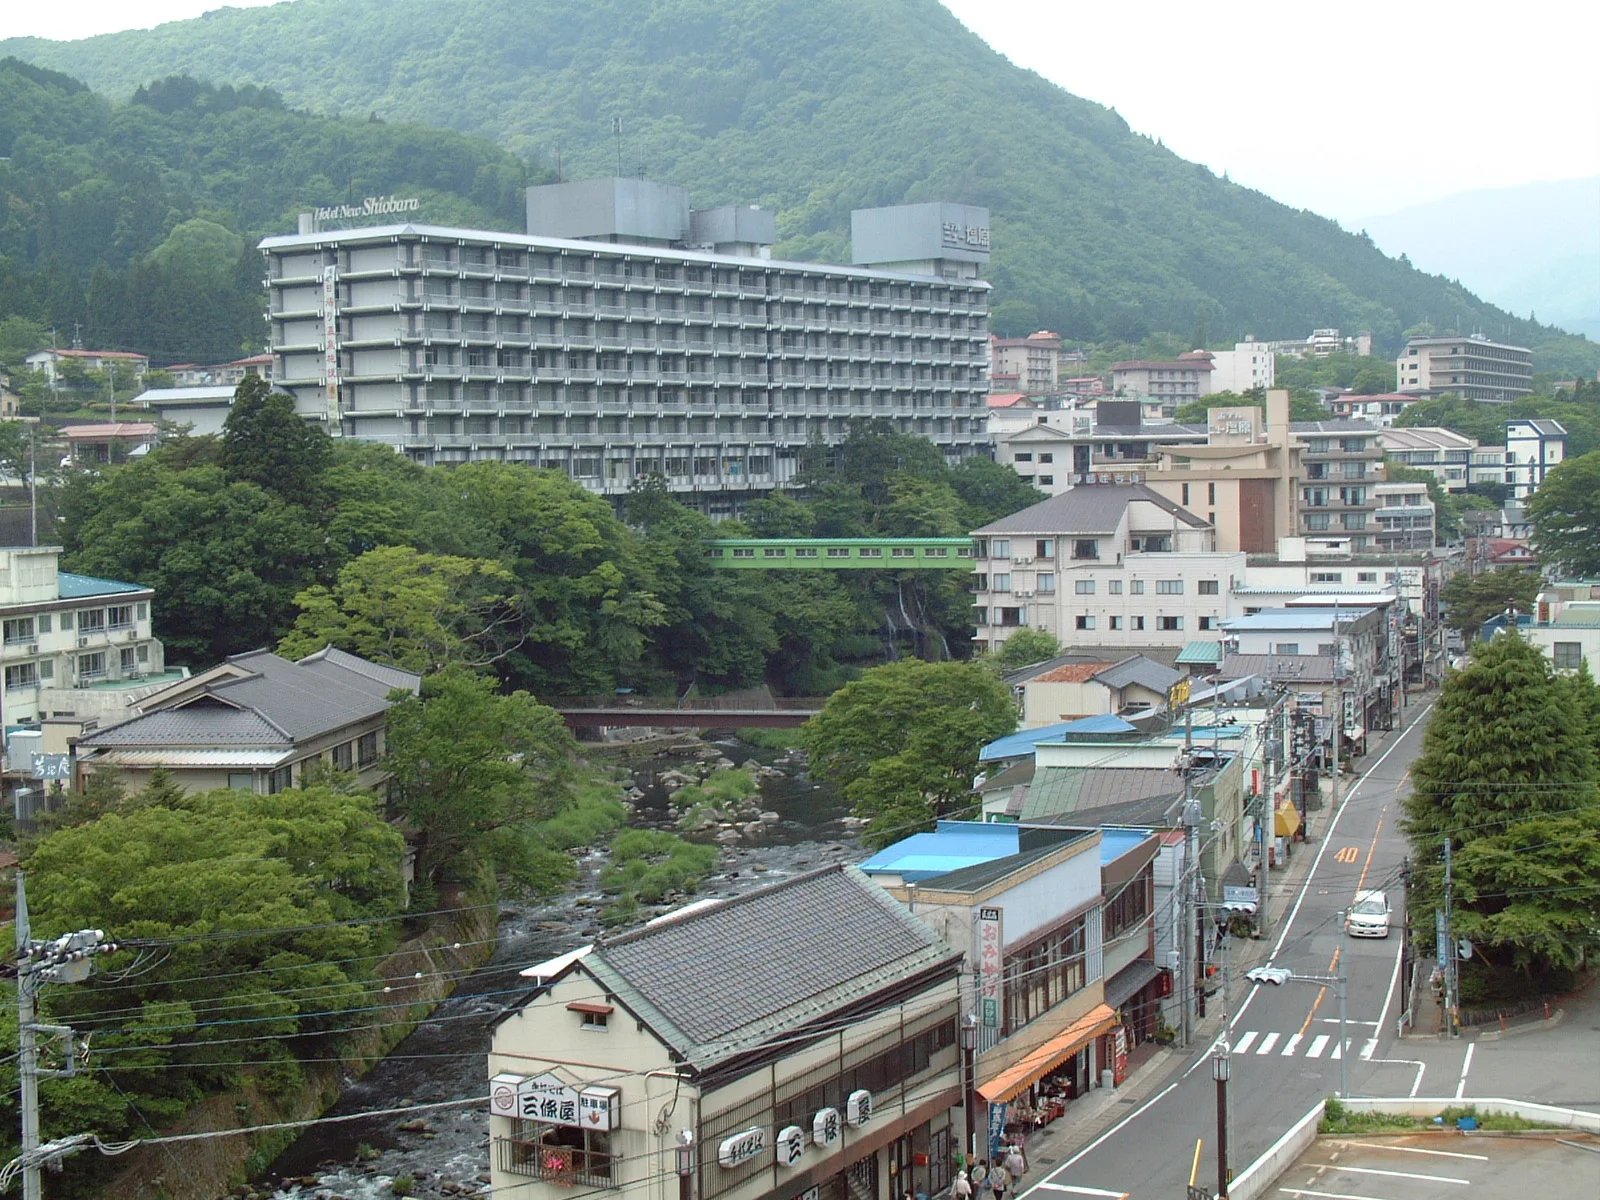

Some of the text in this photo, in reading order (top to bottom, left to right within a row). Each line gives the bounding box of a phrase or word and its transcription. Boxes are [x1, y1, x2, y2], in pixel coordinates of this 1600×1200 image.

[314, 196, 420, 221] Hotel New Shiobara
[1334, 847, 1360, 863] 40
[982, 923, 998, 998] おみやげ
[522, 1096, 576, 1122] 三條屋
